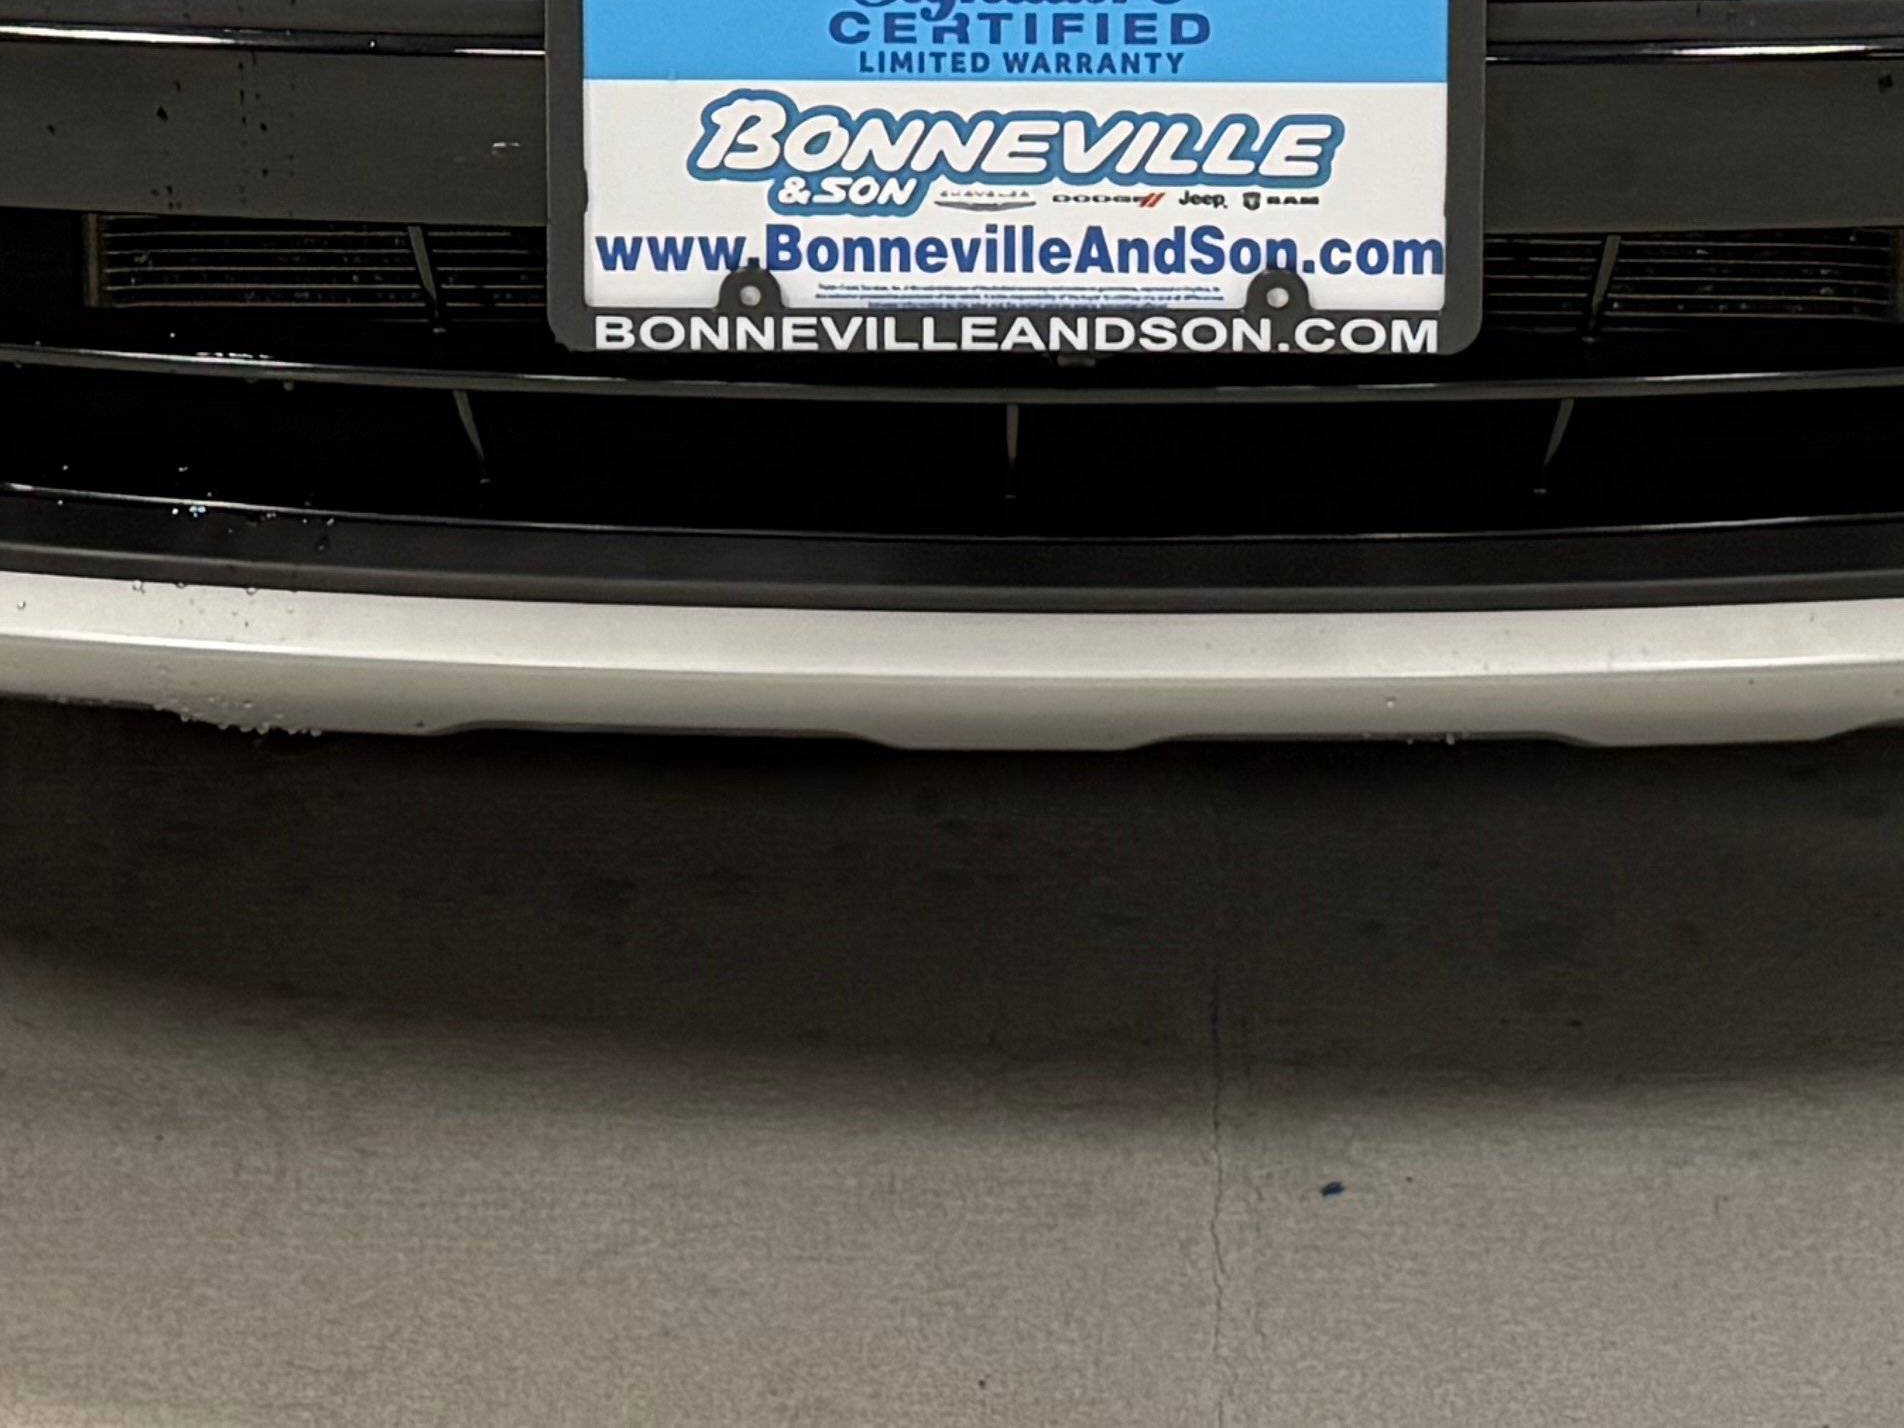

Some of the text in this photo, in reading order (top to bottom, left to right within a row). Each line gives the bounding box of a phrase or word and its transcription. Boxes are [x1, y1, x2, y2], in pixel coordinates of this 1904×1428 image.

[828, 11, 1211, 46] CERTIFIED
[859, 51, 1185, 75] LIMITED WARRANTY
[595, 223, 1446, 275] www.BonnevilleAndSon.com
[595, 315, 1439, 353] BONNEVILLEANDSON.COM
